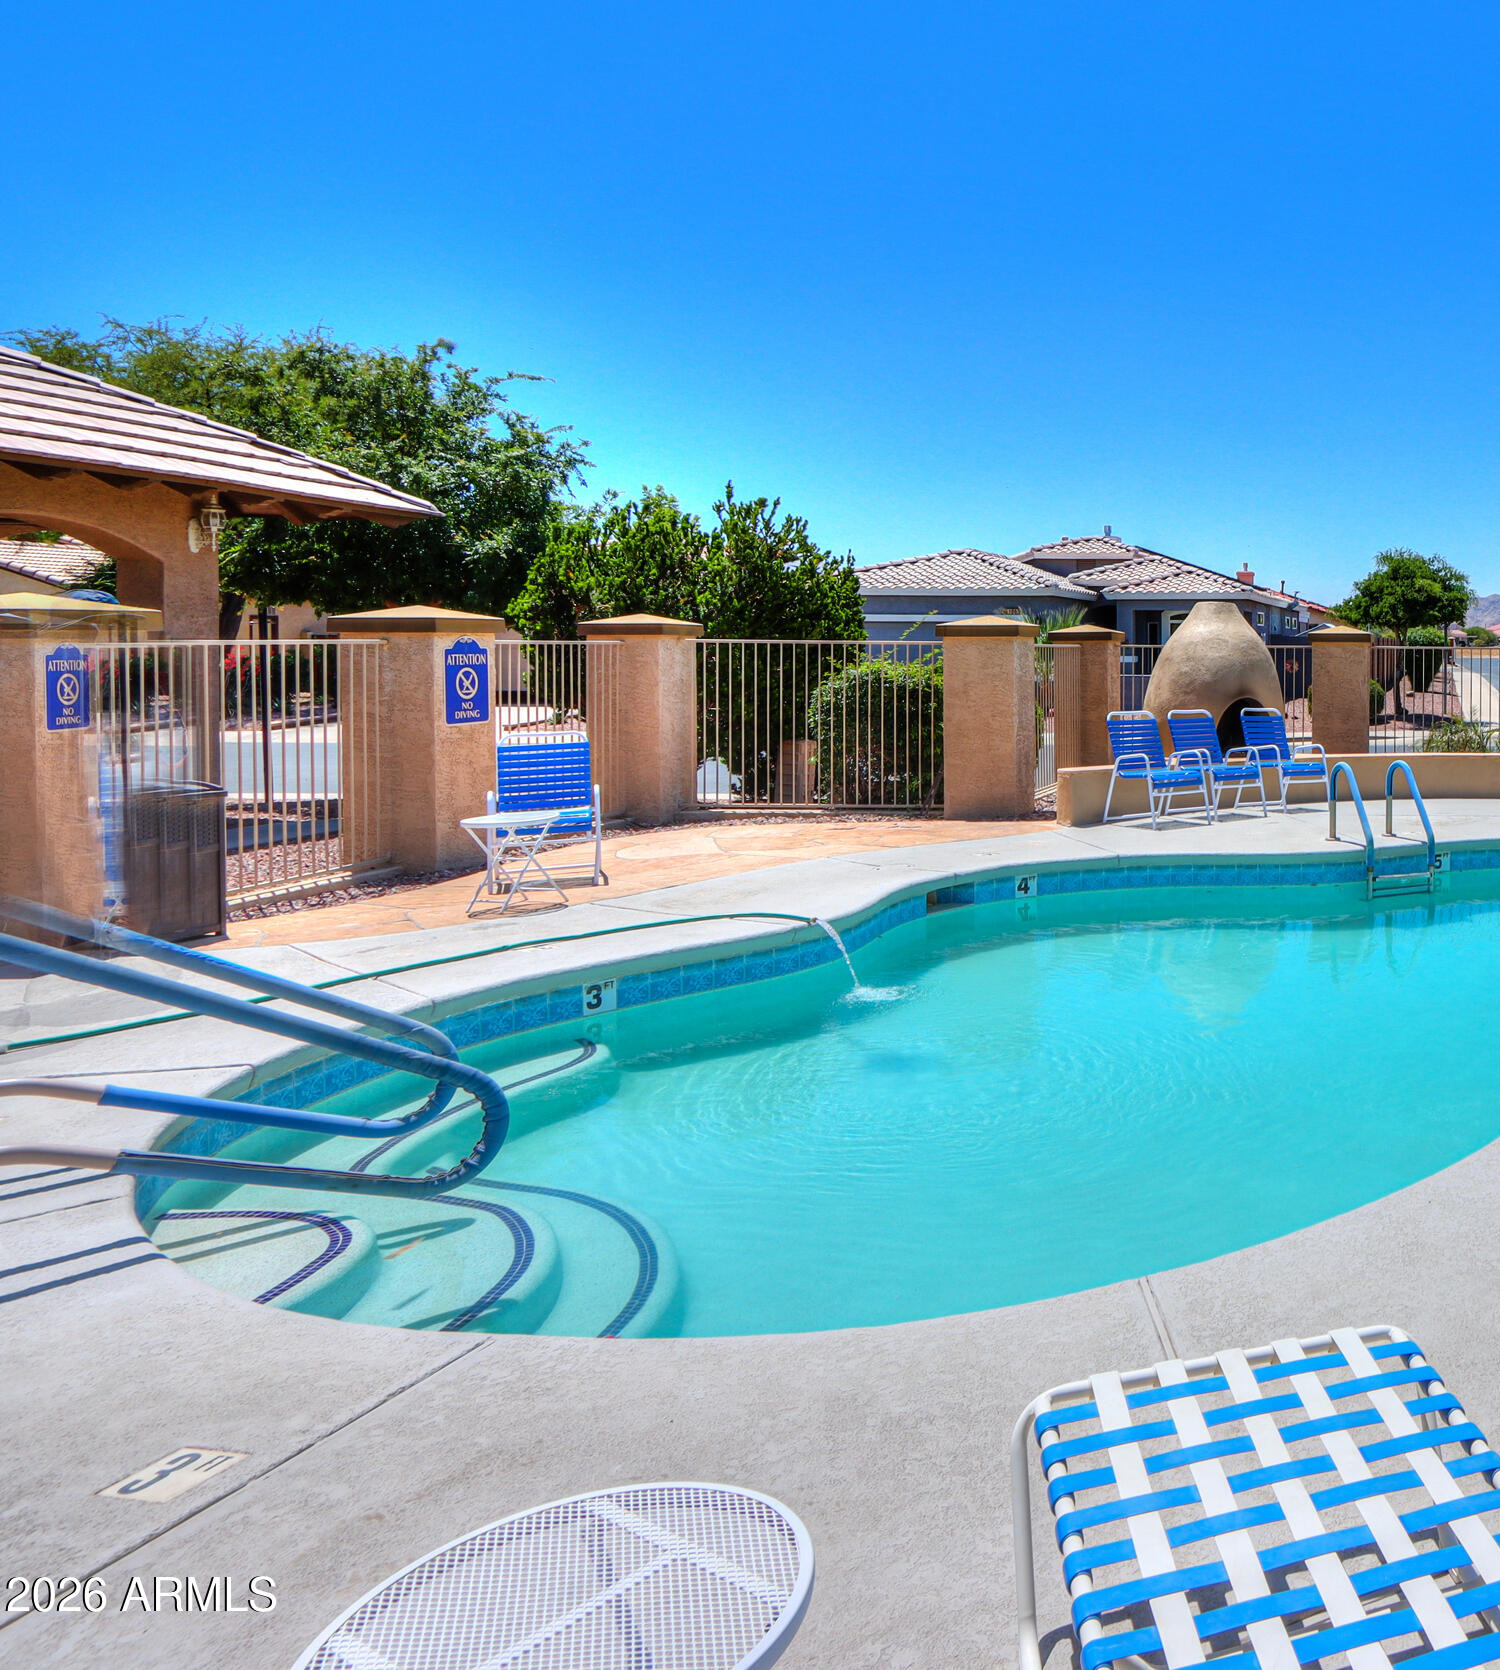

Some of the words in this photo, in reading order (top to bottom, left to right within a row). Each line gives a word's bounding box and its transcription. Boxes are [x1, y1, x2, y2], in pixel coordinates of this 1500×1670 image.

[48, 660, 88, 672] ATTENTION
[447, 654, 487, 666] ATTENTION
[462, 701, 474, 709] NO
[63, 707, 75, 716] NO
[455, 710, 480, 719] DIVING
[56, 716, 81, 725] DIVING
[1435, 854, 1442, 869] 5
[1017, 877, 1030, 895] 4
[586, 985, 602, 1010] 3
[604, 980, 615, 989] FT
[117, 1453, 202, 1494] 3
